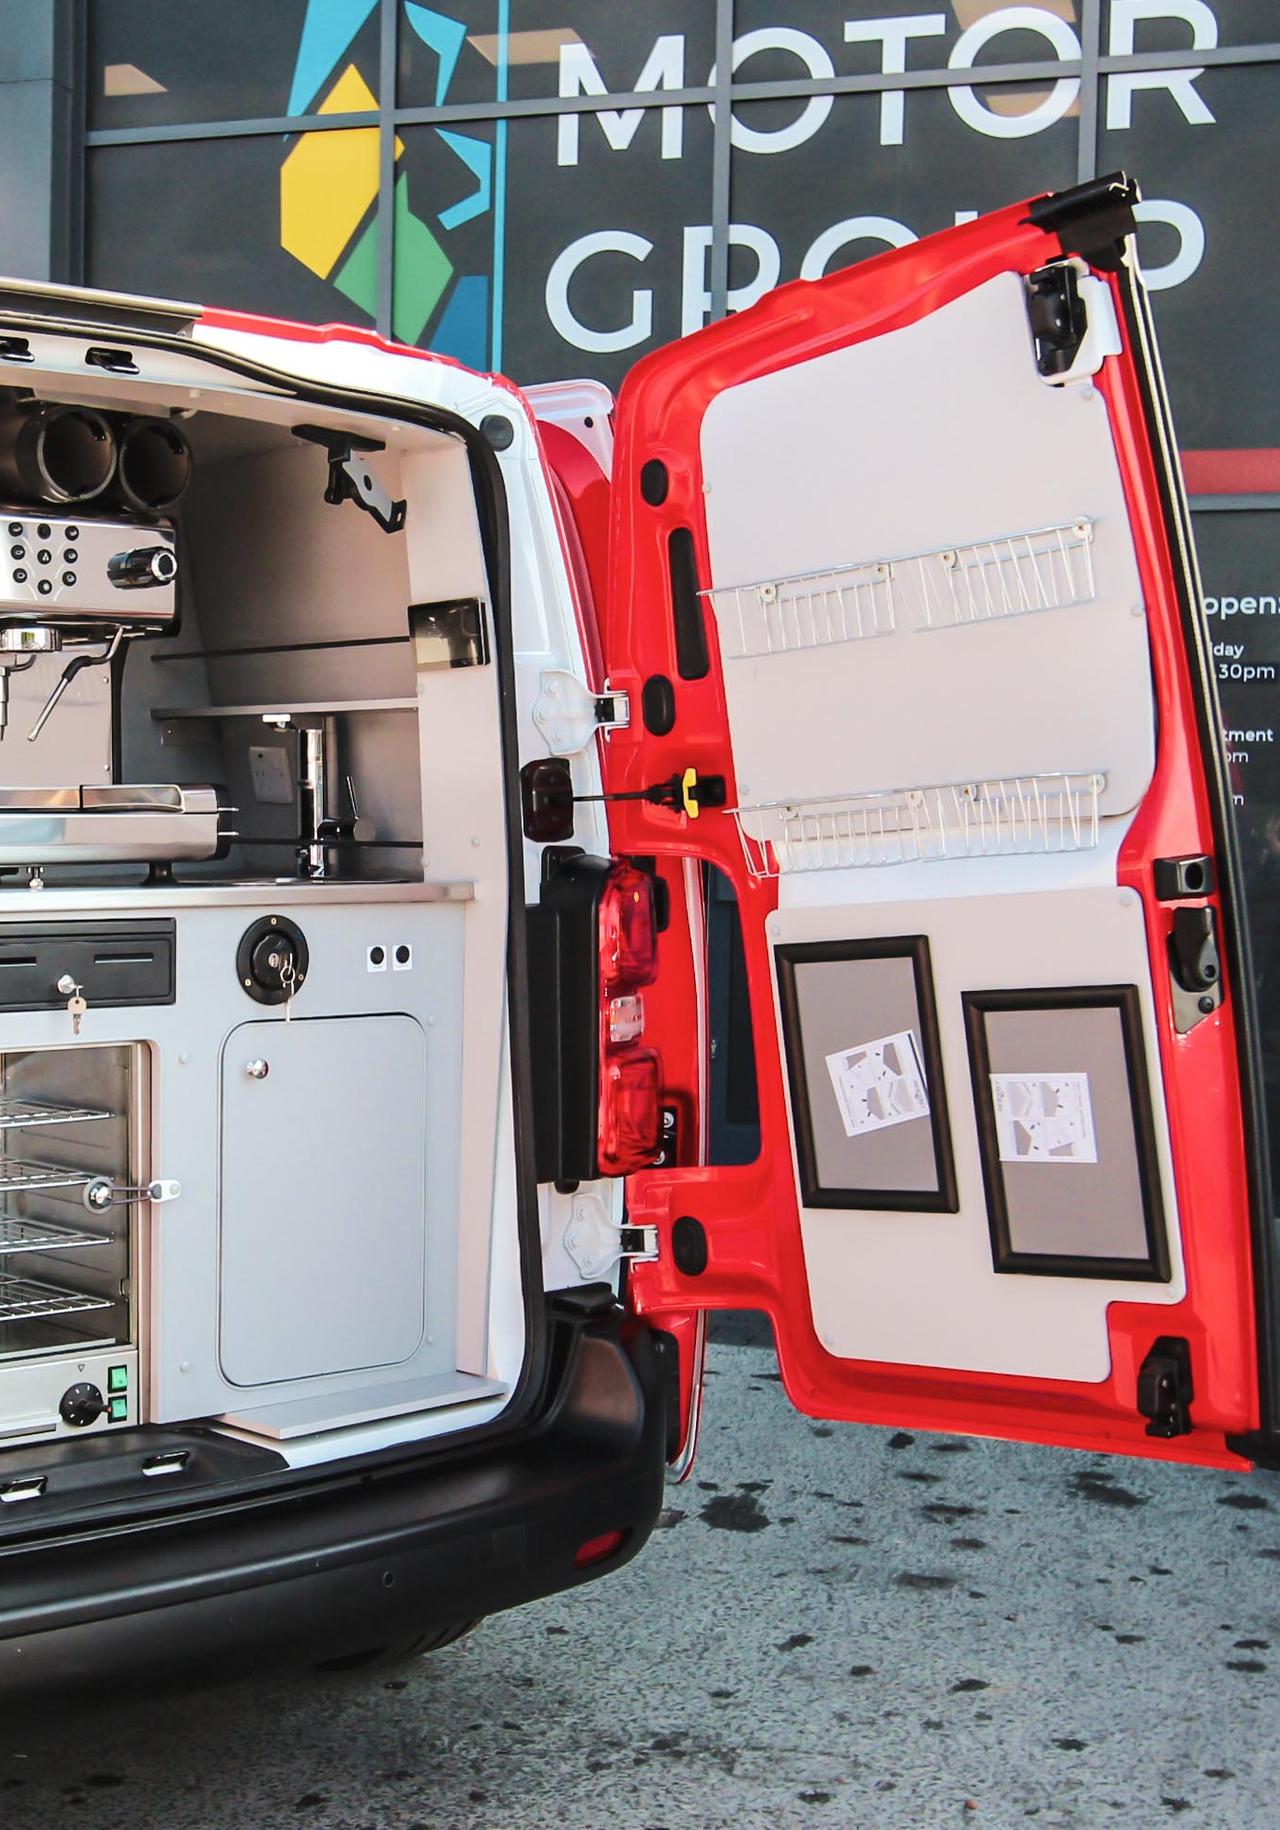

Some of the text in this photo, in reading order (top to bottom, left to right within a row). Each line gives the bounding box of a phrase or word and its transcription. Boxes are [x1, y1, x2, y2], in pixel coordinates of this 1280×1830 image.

[557, 0, 1218, 166] MOTOR
[545, 200, 1205, 353] GRP
[1201, 596, 1280, 620] open
[1210, 641, 1244, 660] day
